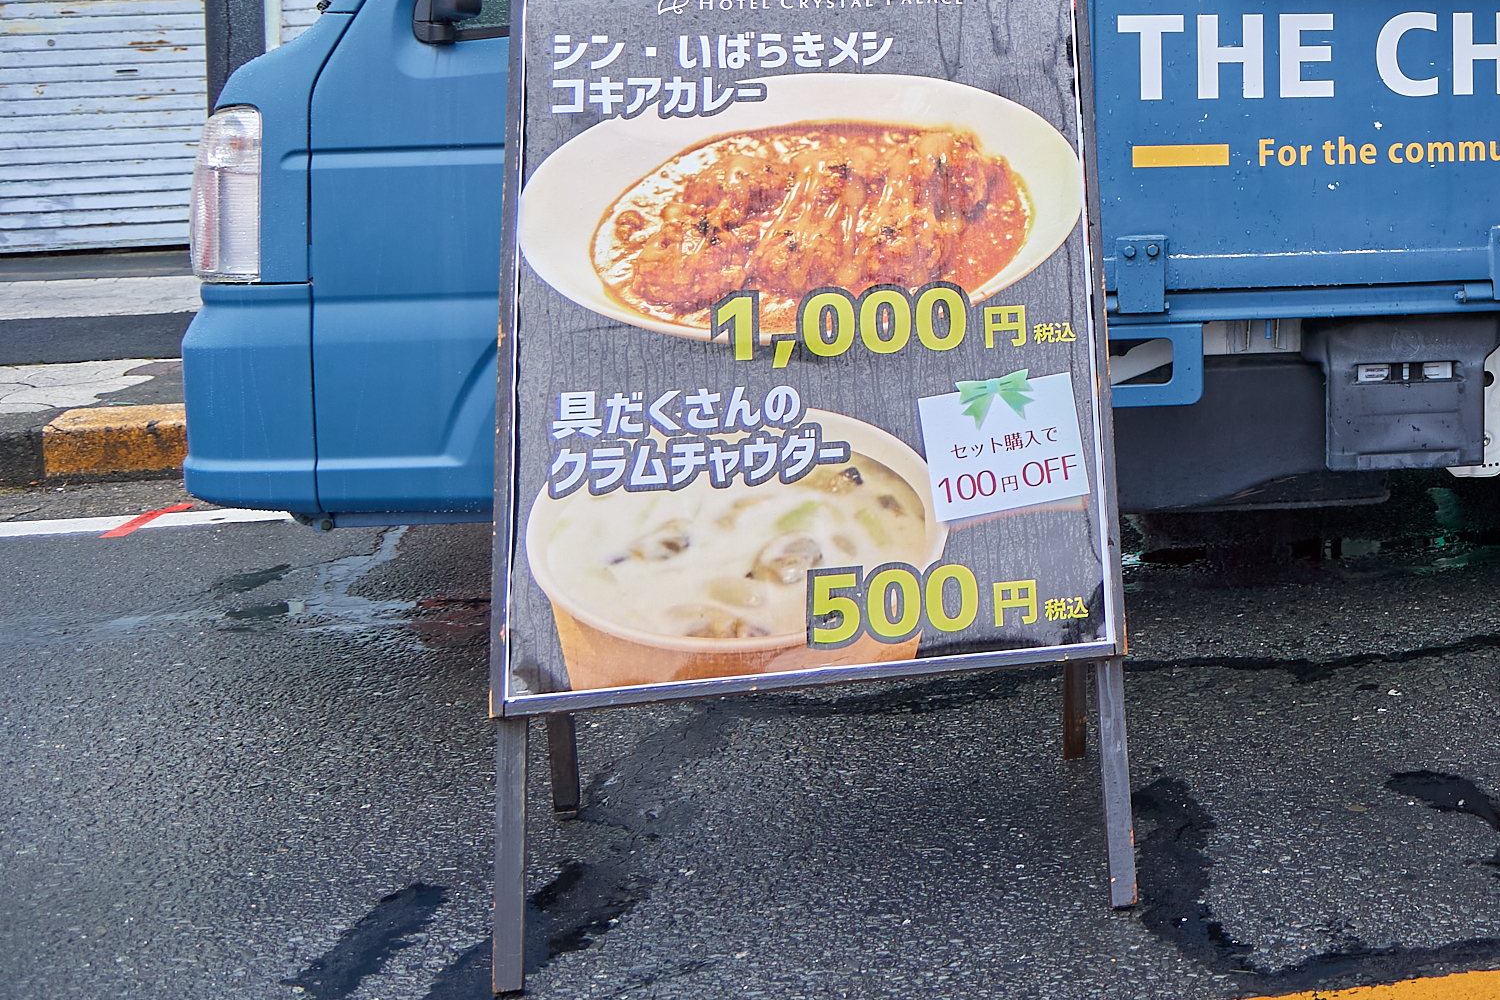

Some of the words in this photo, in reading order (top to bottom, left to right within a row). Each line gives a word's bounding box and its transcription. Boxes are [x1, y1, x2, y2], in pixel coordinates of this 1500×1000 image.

[1117, 13, 1335, 100] THE
[552, 76, 762, 115] コキアカレー
[1259, 138, 1312, 167] For
[1322, 136, 1377, 165] the
[552, 385, 801, 440] 具だくさんの
[551, 430, 844, 493] クラムチャウダー
[951, 427, 1057, 459] セット購入で
